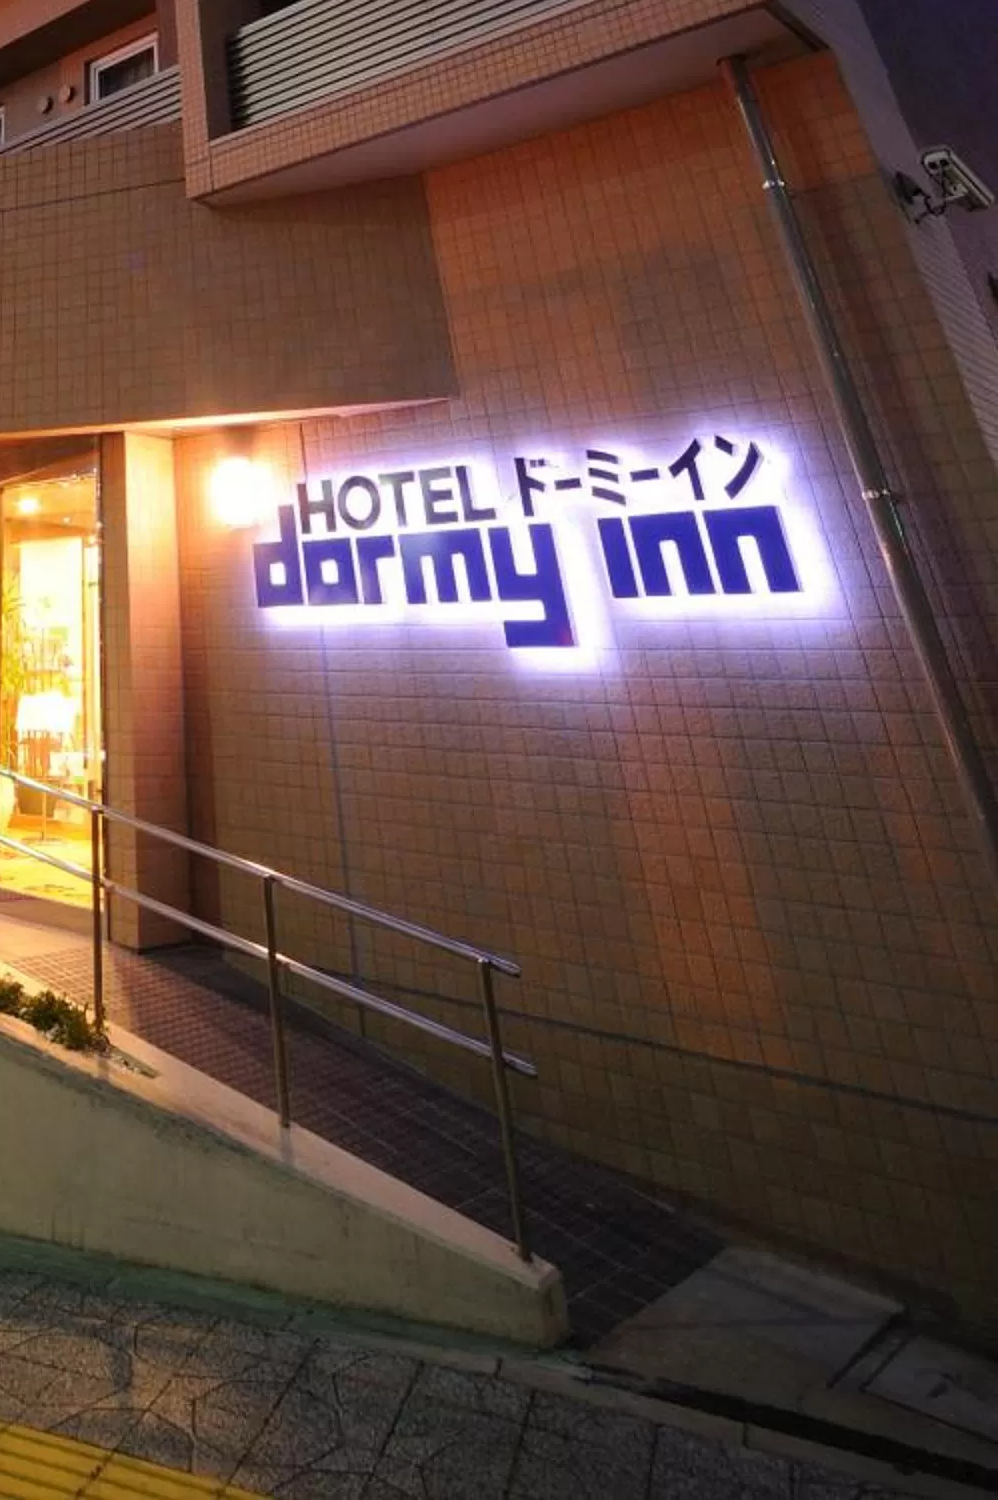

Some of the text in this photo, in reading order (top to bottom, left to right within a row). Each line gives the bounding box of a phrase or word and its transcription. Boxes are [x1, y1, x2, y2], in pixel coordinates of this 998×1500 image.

[297, 465, 497, 535] HOTEL
[513, 434, 762, 517] ドーミーイン
[253, 504, 803, 648] dormy inn
